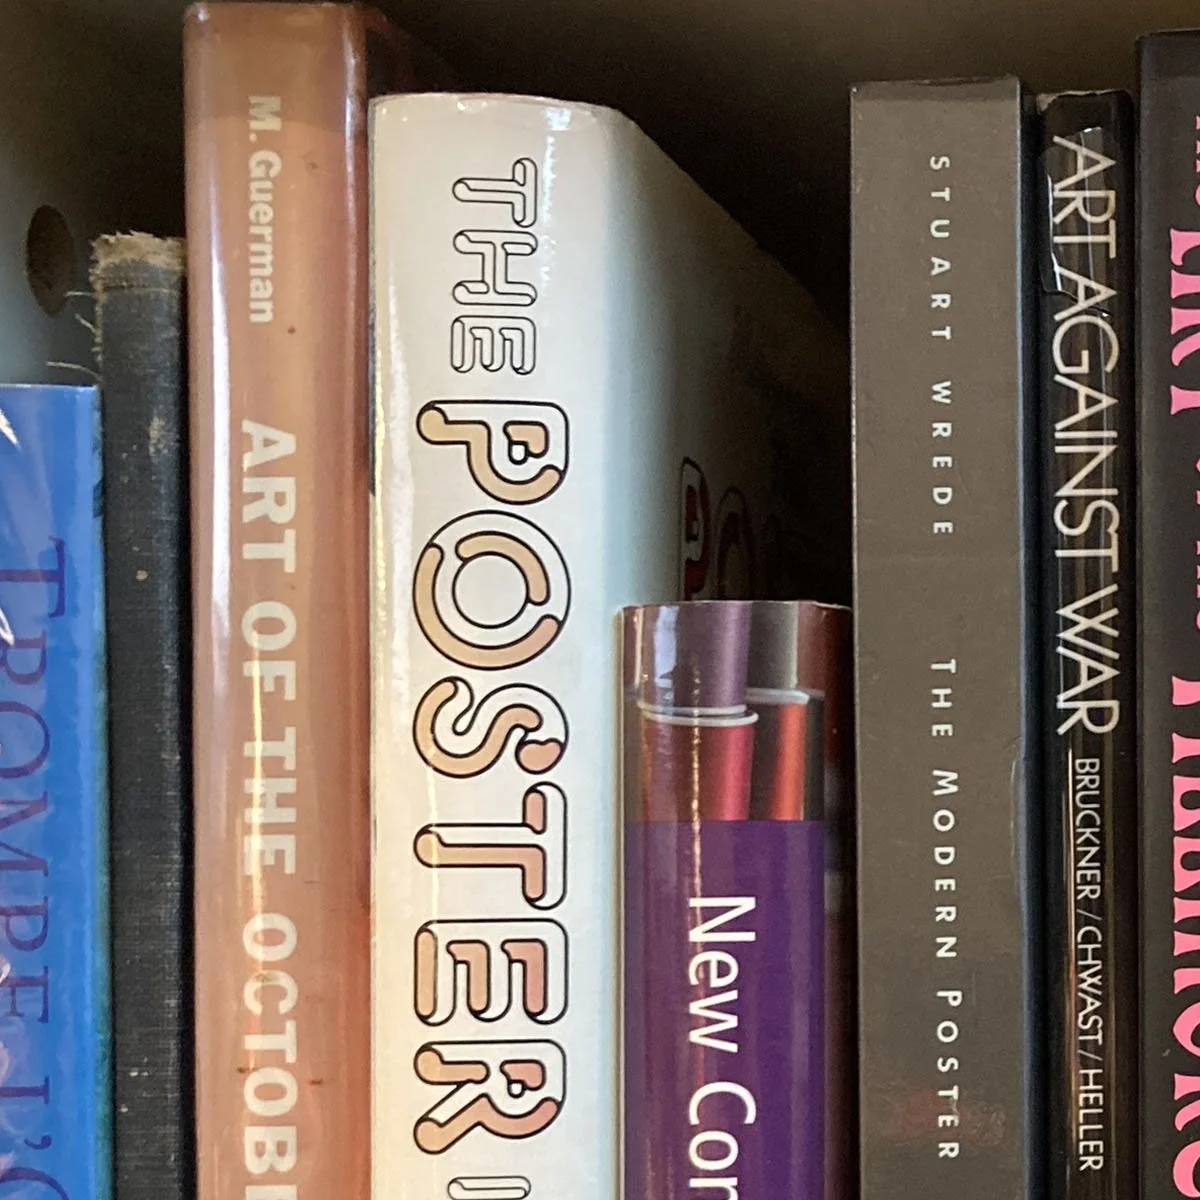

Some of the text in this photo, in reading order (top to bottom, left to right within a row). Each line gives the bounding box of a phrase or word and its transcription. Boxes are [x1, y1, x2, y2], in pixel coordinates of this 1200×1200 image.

[246, 95, 282, 323] M. Guerman
[451, 159, 539, 376] THE
[931, 158, 953, 534] STUART WREDE
[1052, 134, 1120, 736] ART AGAINST WAR
[244, 421, 297, 573] ART
[243, 602, 297, 699] OF
[242, 726, 298, 877] THE
[413, 401, 572, 1156] POSTER
[688, 894, 757, 1054] New
[932, 660, 963, 1158] THE MODERN POSTER
